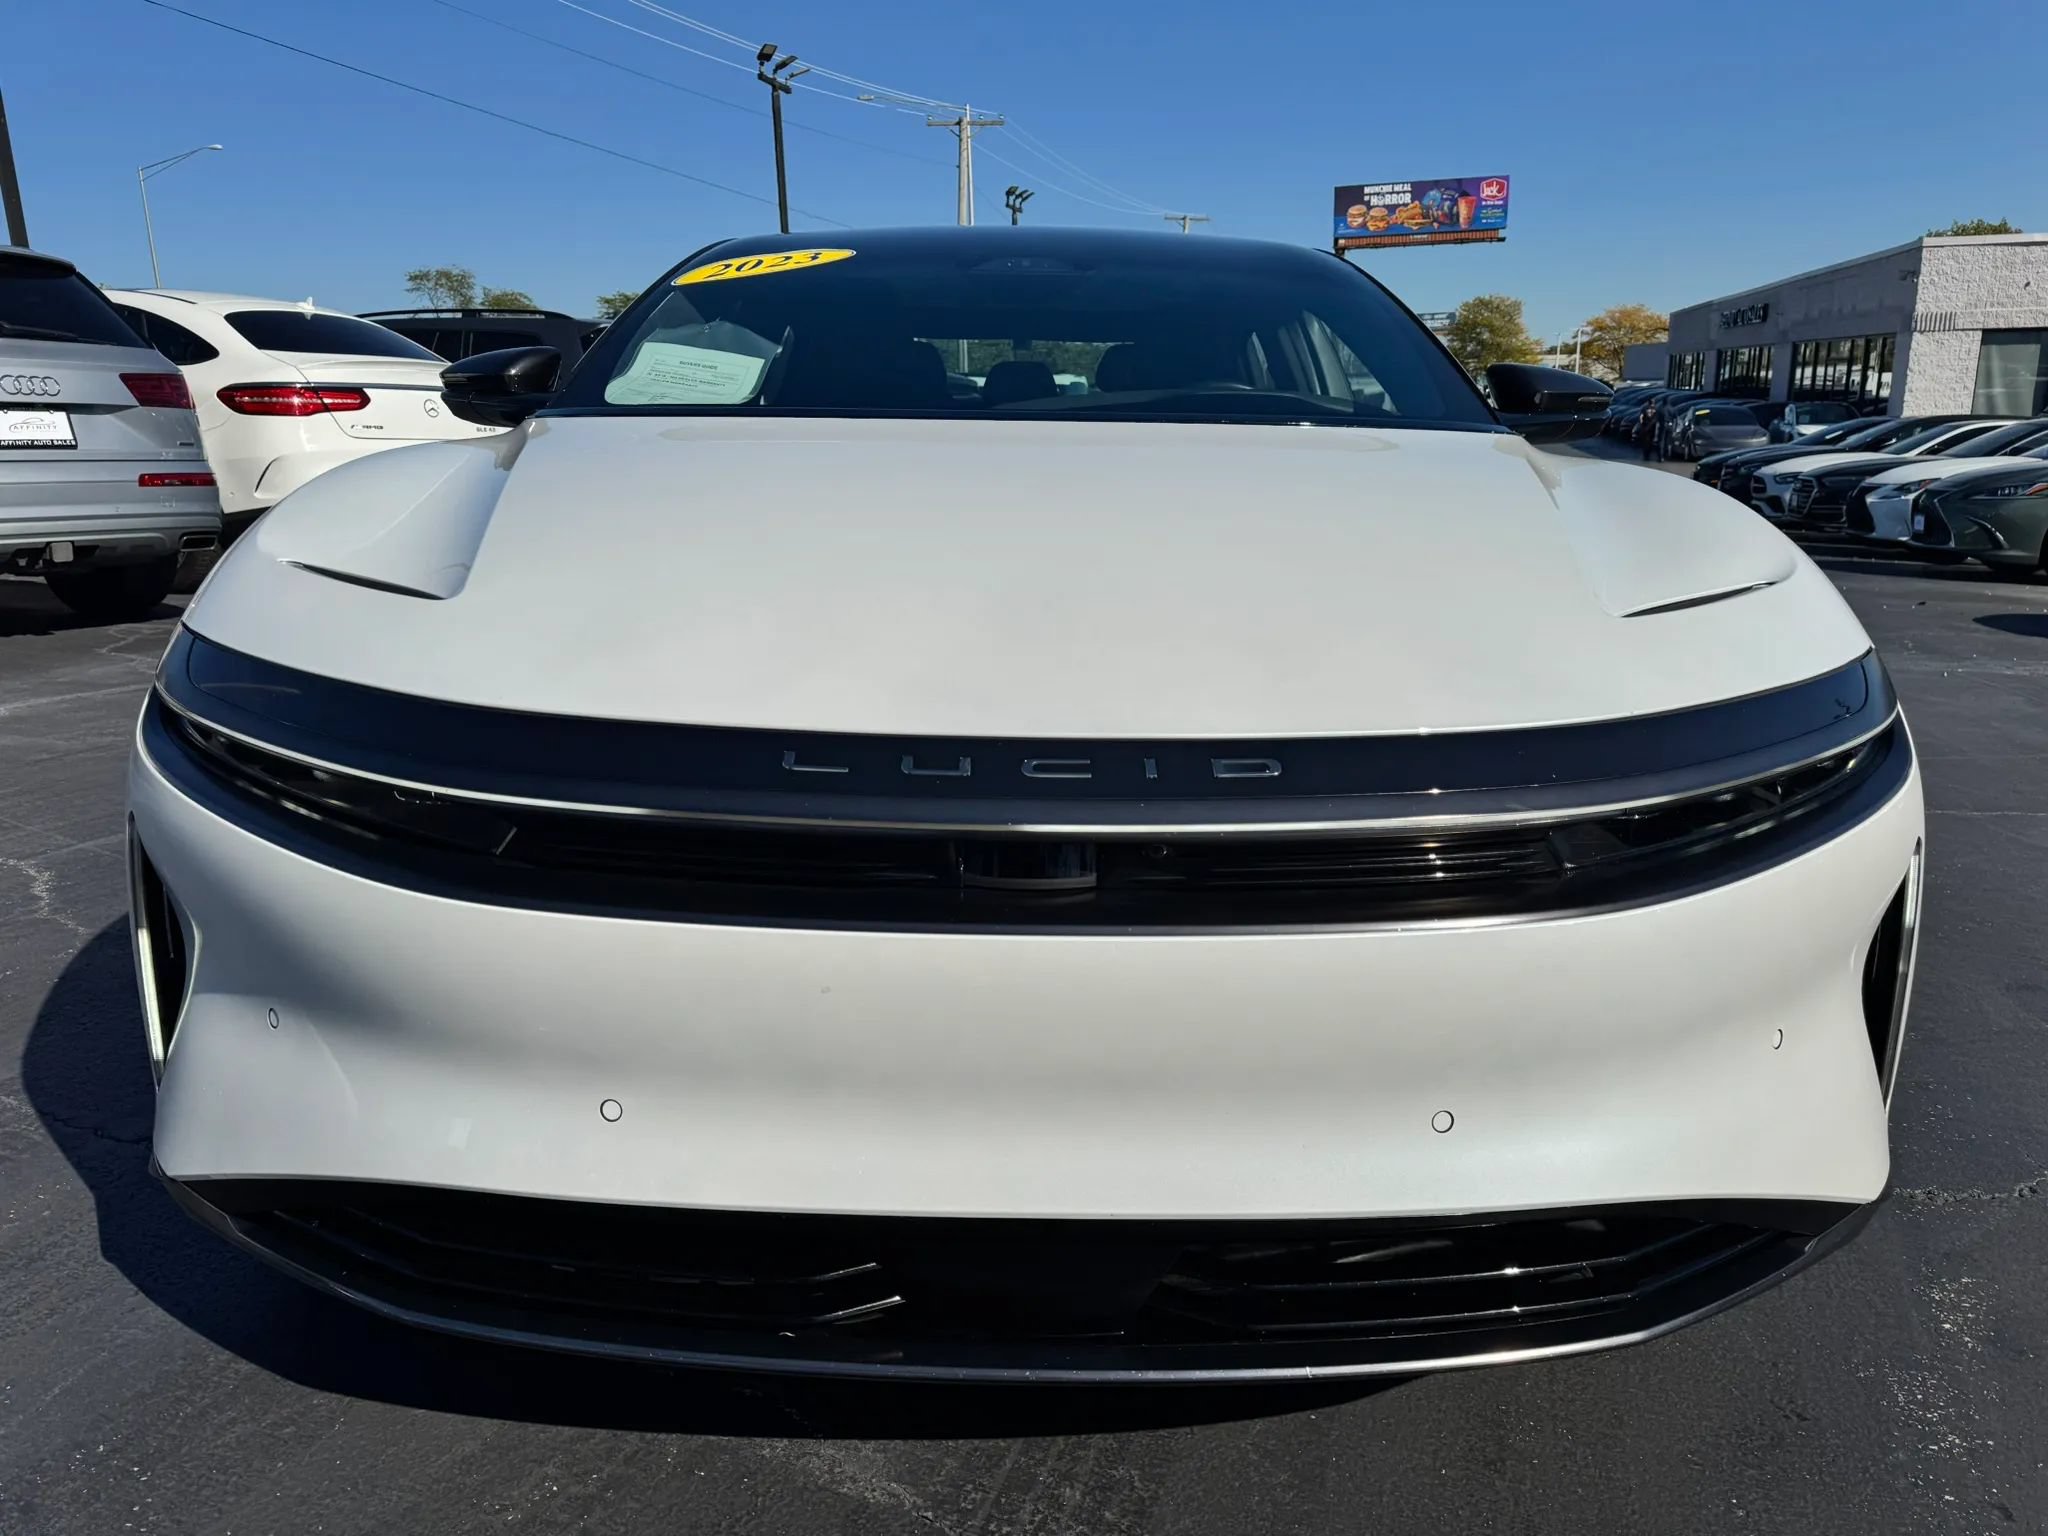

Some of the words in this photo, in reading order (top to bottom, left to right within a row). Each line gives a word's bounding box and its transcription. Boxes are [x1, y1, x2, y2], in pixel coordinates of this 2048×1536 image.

[1370, 192, 1412, 206] HORROR
[1482, 180, 1504, 197] Jack
[703, 252, 823, 279] 2023
[782, 750, 1283, 779] LUCID
